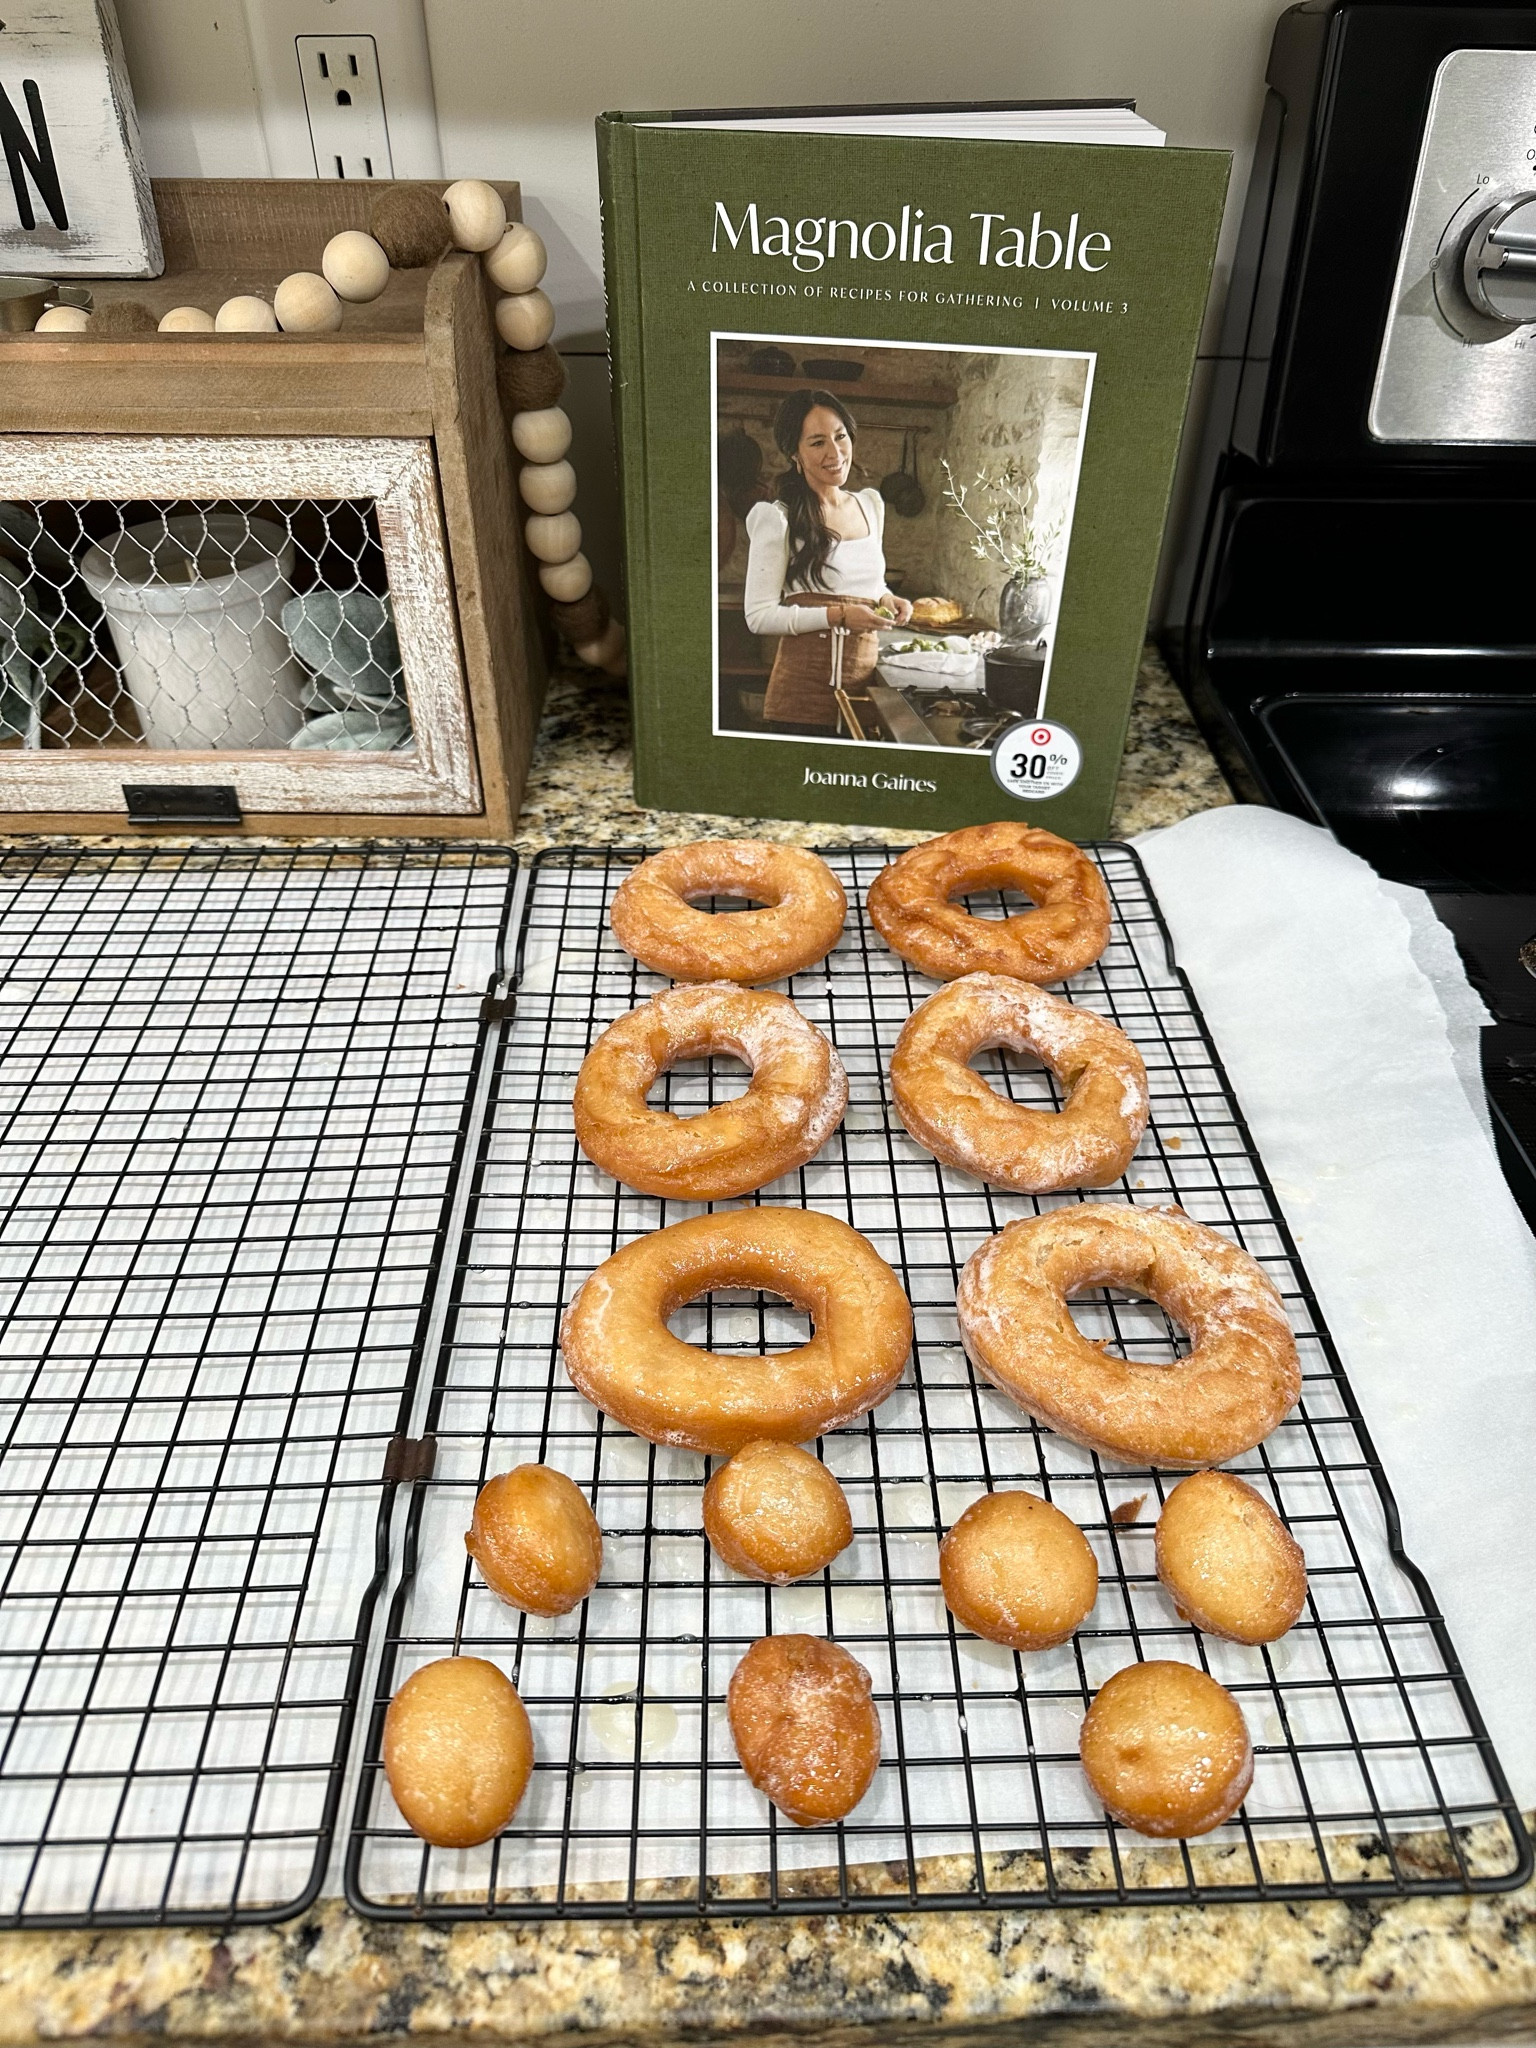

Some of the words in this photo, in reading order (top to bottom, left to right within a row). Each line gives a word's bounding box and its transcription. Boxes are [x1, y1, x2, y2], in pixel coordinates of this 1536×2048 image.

[1476, 173, 1490, 185] Lo
[710, 200, 955, 274] Magnolia
[969, 210, 1112, 273] Table
[687, 280, 697, 293] A
[702, 280, 798, 296] COLLECTION
[803, 285, 824, 298] OF
[830, 286, 892, 301] RECIPES
[899, 289, 929, 303] FOR
[935, 291, 1024, 308] GATHERING
[1050, 297, 1115, 314] VOLUME
[1119, 301, 1129, 315] 3
[802, 766, 868, 788] Joanna
[871, 771, 938, 794] Gaines
